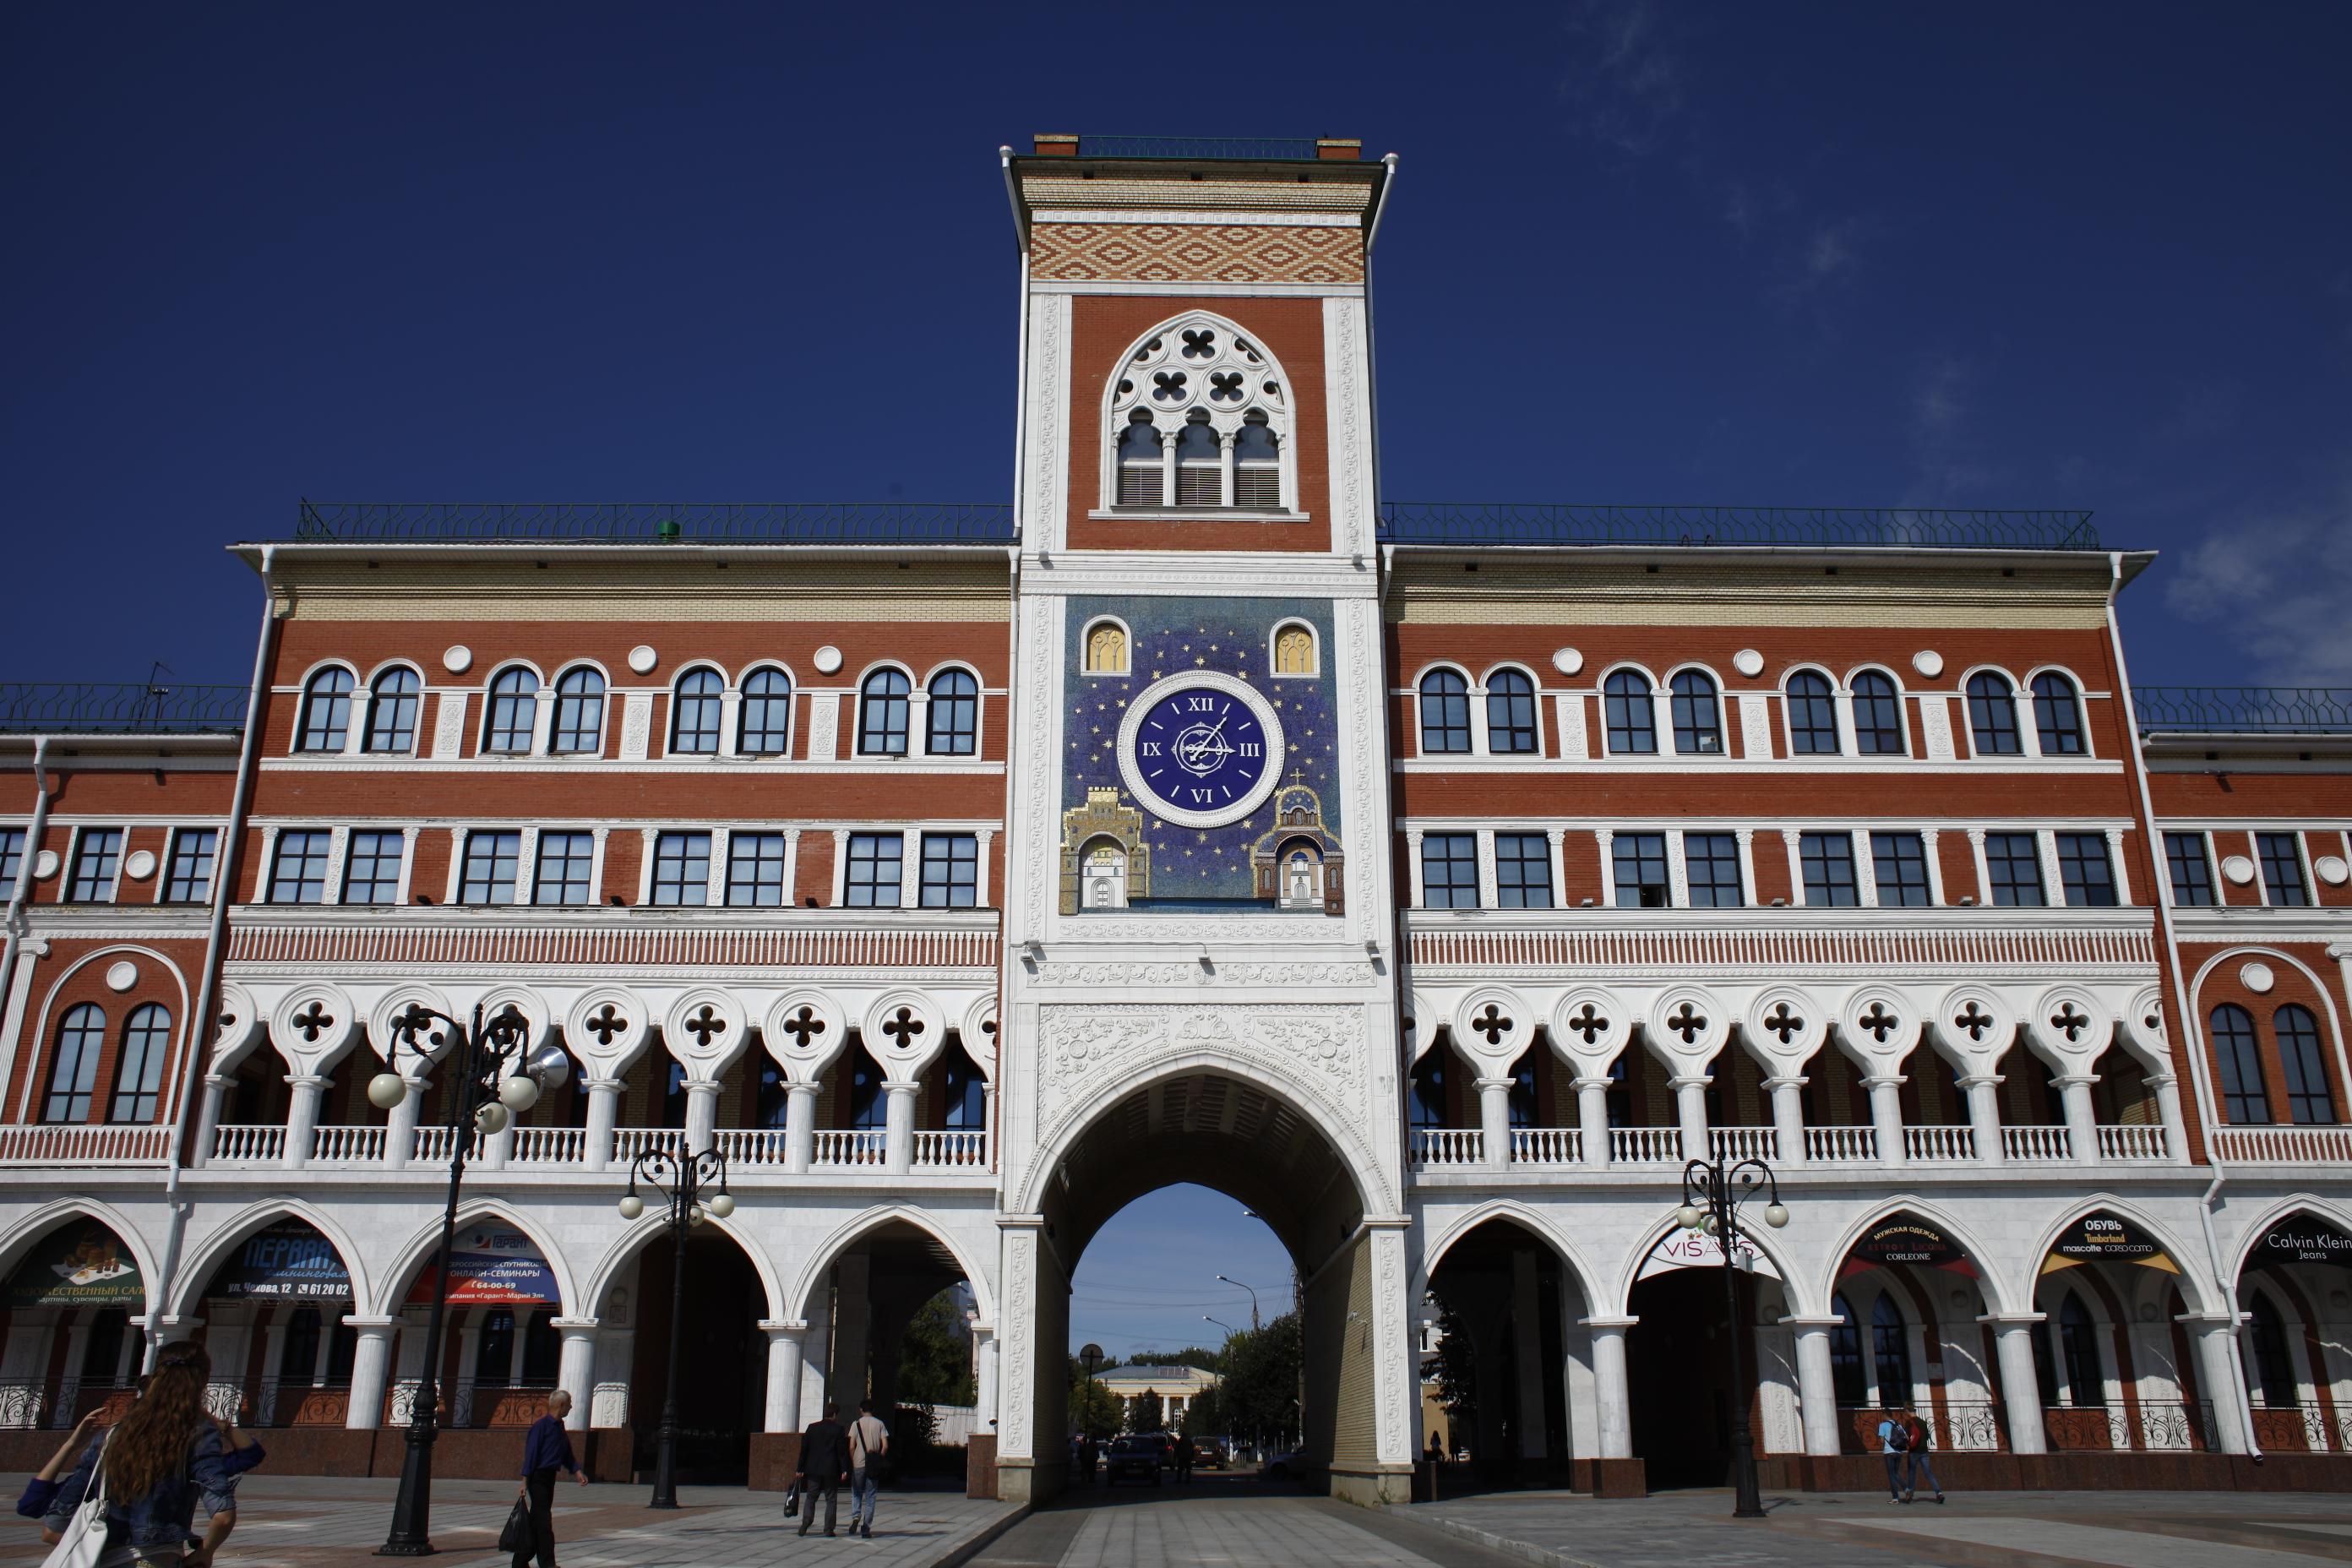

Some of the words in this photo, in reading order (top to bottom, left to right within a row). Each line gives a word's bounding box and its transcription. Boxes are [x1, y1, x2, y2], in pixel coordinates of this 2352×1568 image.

[1188, 698, 1213, 711] XII
[1142, 743, 1162, 756] IX
[1239, 743, 1260, 757] III
[1190, 789, 1212, 803] VI
[2085, 1220, 2122, 1231] ОБУВЬ
[1873, 1226, 1908, 1241] МУЖСКАЯ
[1909, 1226, 1940, 1242] ОДЕЖДА
[2085, 1233, 2126, 1243] Timberland
[2268, 1233, 2314, 1248] Calvin
[2317, 1233, 2352, 1249] Klein
[2299, 1249, 2327, 1260] Jeans
[448, 1260, 499, 1268] СЕРОССИЙСКИЕ
[450, 1269, 540, 1277] ОНЛАЙН-СЕМИНАРЫ
[228, 1283, 241, 1293] ул.
[243, 1282, 279, 1294] Чехова,
[281, 1282, 291, 1293] 12
[309, 1283, 320, 1294] 61
[321, 1283, 335, 1294] 20
[335, 1283, 349, 1295] 02
